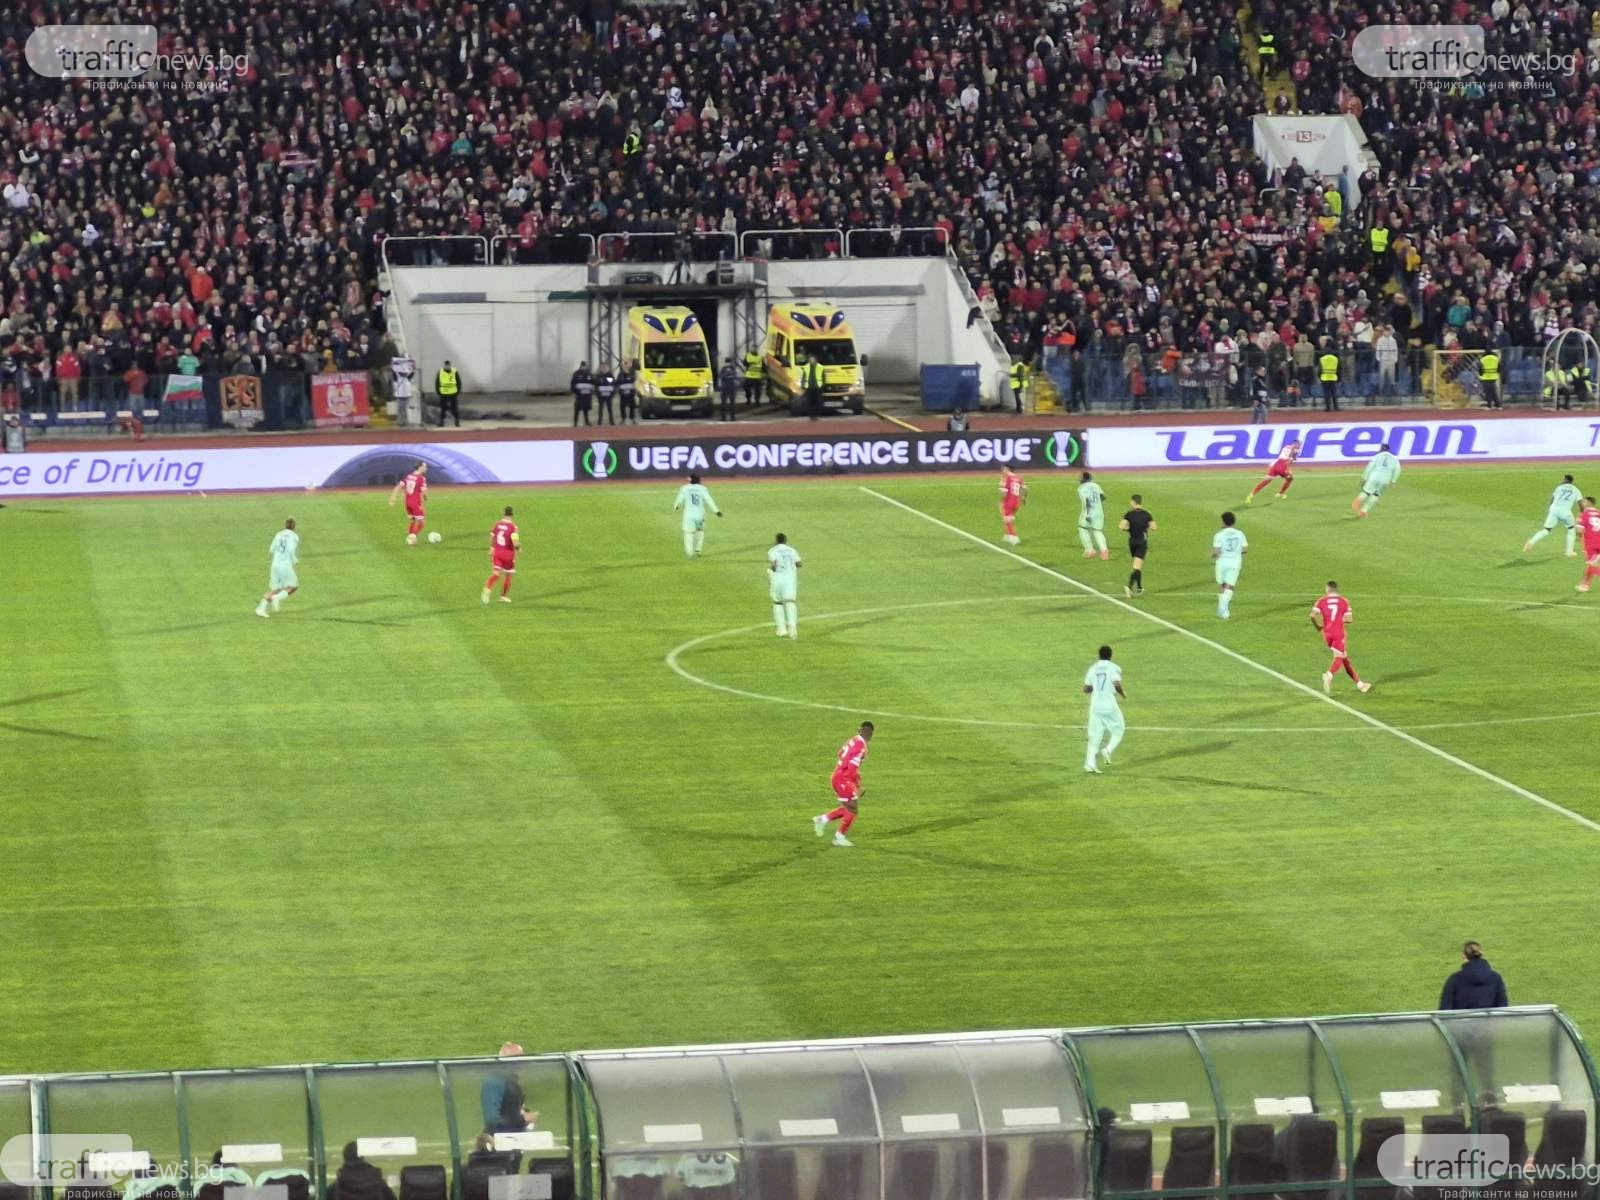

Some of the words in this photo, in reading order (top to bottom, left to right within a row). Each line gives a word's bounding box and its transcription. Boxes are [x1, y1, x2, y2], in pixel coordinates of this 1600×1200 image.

[628, 445, 710, 471] UEFA
[714, 440, 909, 469] CONFERENCE
[917, 438, 1032, 464] LEAGUE
[44, 458, 80, 485] of
[86, 457, 204, 487] Driving
[1559, 488, 1573, 501] 72
[496, 531, 506, 546] 6
[1327, 604, 1338, 622] 7
[1096, 673, 1107, 691] 17
